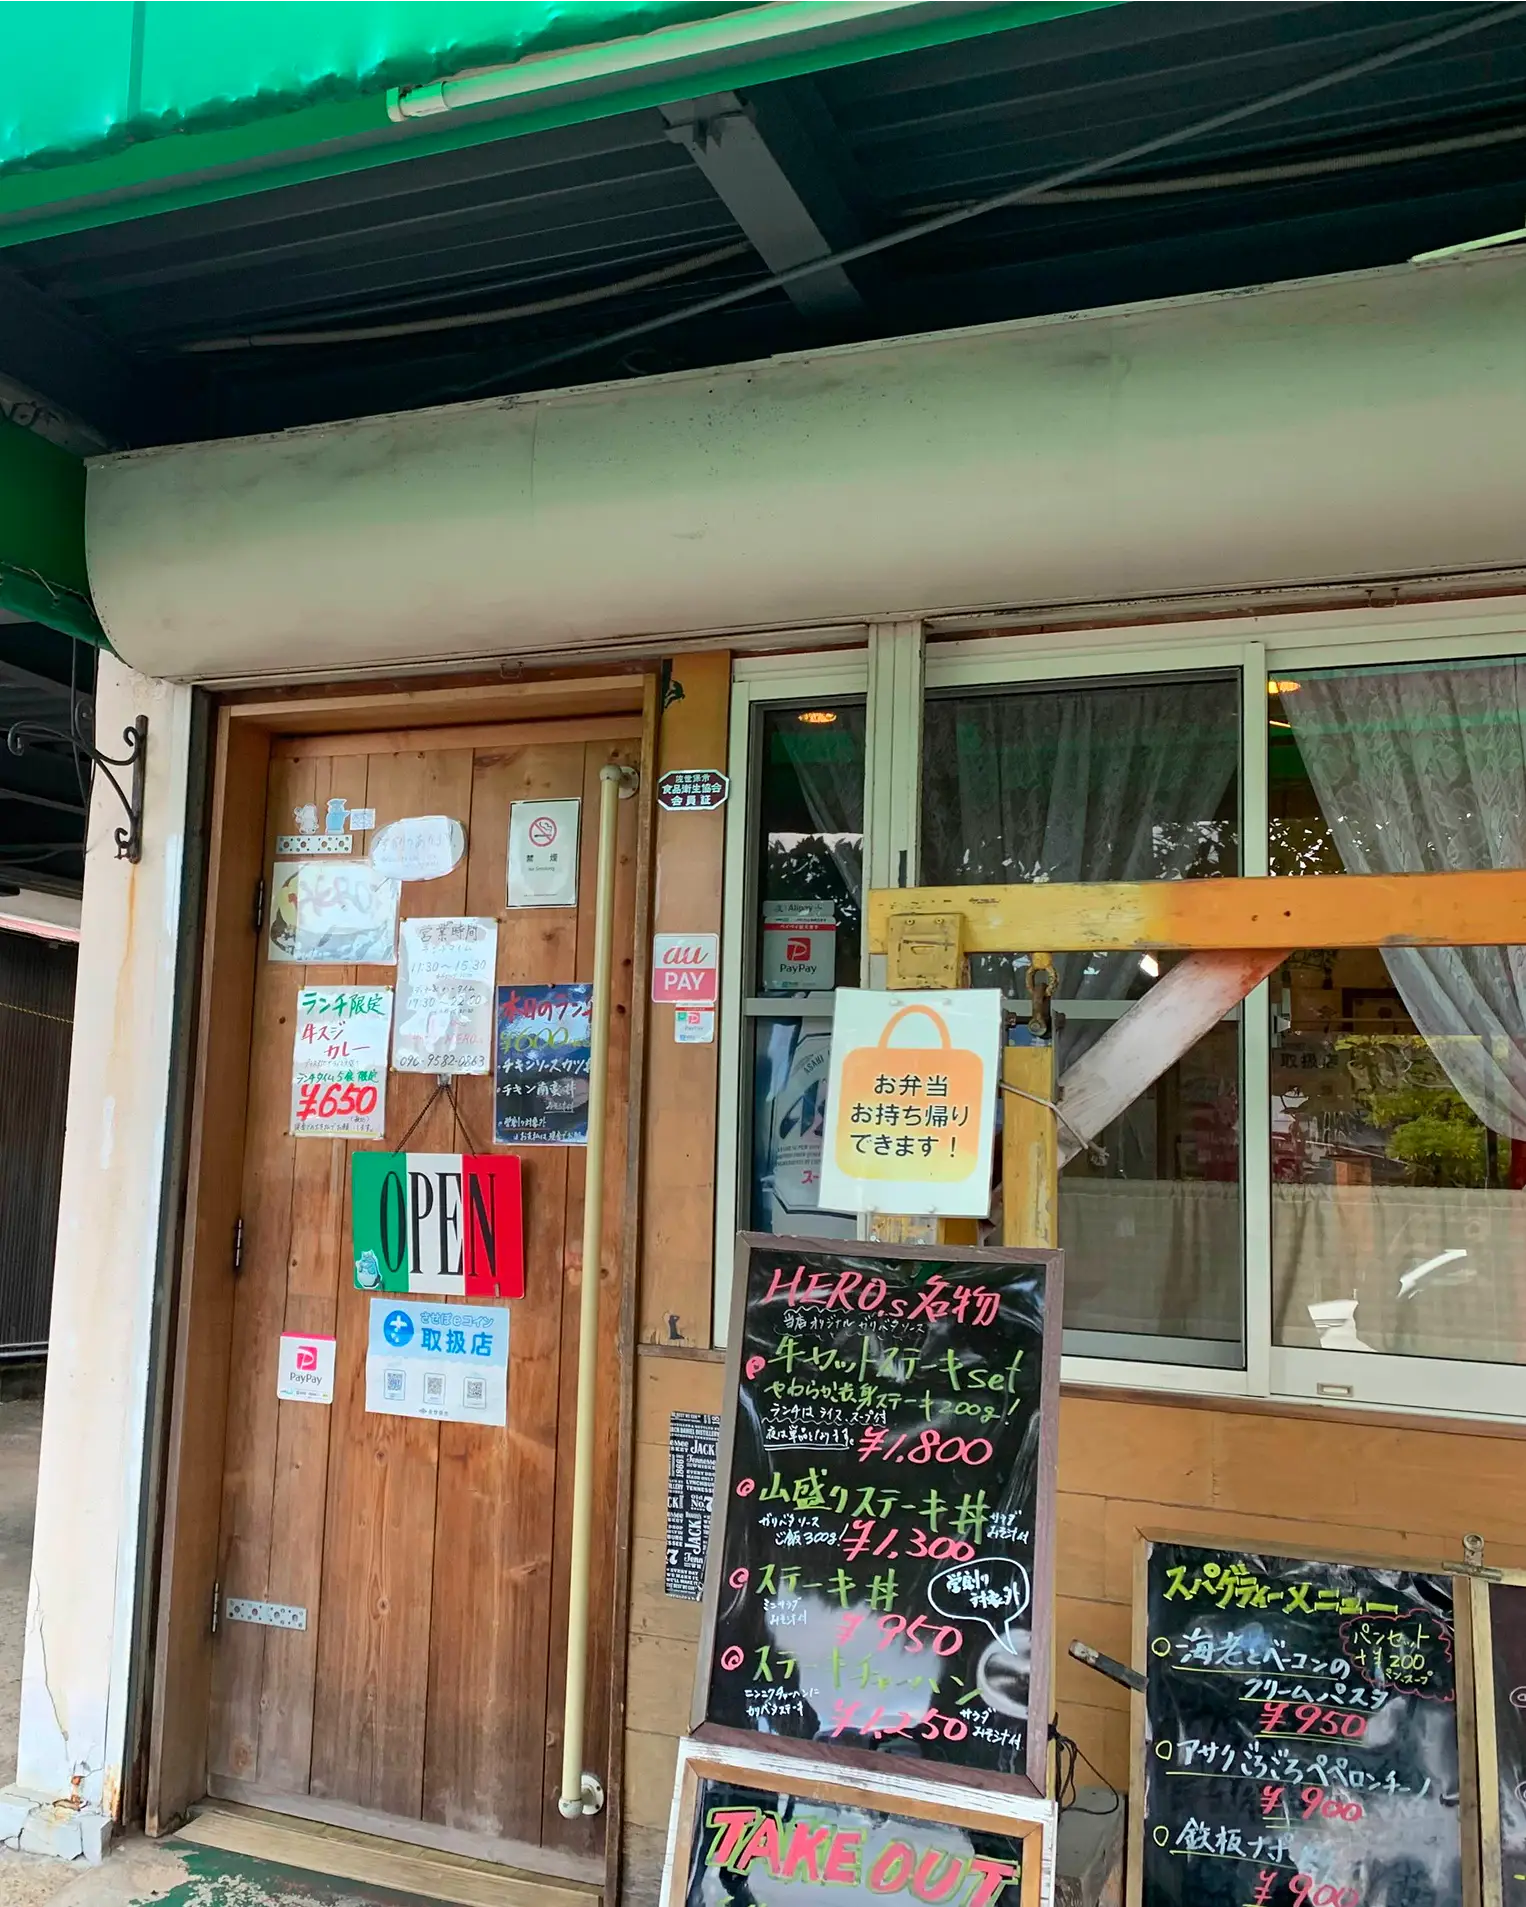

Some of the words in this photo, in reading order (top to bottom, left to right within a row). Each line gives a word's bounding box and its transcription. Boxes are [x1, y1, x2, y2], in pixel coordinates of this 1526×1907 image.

[662, 782, 722, 794] 食品衛生協会
[671, 795, 711, 806] 会員証
[417, 925, 479, 943] 営業時間
[663, 945, 708, 966] au
[664, 972, 706, 991] PAY
[780, 964, 817, 975] PayPay
[302, 992, 386, 1018] ランチ限定
[302, 1021, 347, 1044] 牛スジ
[324, 1042, 370, 1060] カレー
[874, 1074, 948, 1097] お弁当
[296, 1082, 378, 1121] ¥650
[850, 1103, 969, 1128] お持ち帰り
[850, 1134, 957, 1158] できます！
[380, 1171, 497, 1277] OPEN
[421, 1327, 494, 1357] 取扱店
[289, 1371, 322, 1385] PayPay
[690, 1440, 715, 1455] JACK
[684, 1518, 702, 1554] JACK
[756, 1563, 898, 1612] ステーキ丼
[1162, 1562, 1400, 1615] スパゲティーメニュー
[836, 1612, 964, 1656] ¥950
[1353, 1623, 1430, 1650] パンセット
[1175, 1627, 1351, 1681] 海老とベーコンの
[1243, 1678, 1390, 1710] クリームパスタ
[959, 1706, 997, 1725] サラダ
[1259, 1702, 1368, 1738] ¥950
[1260, 1785, 1364, 1823] ¥900
[707, 1806, 866, 1885] TAKE
[867, 1838, 1020, 1907] OUT
